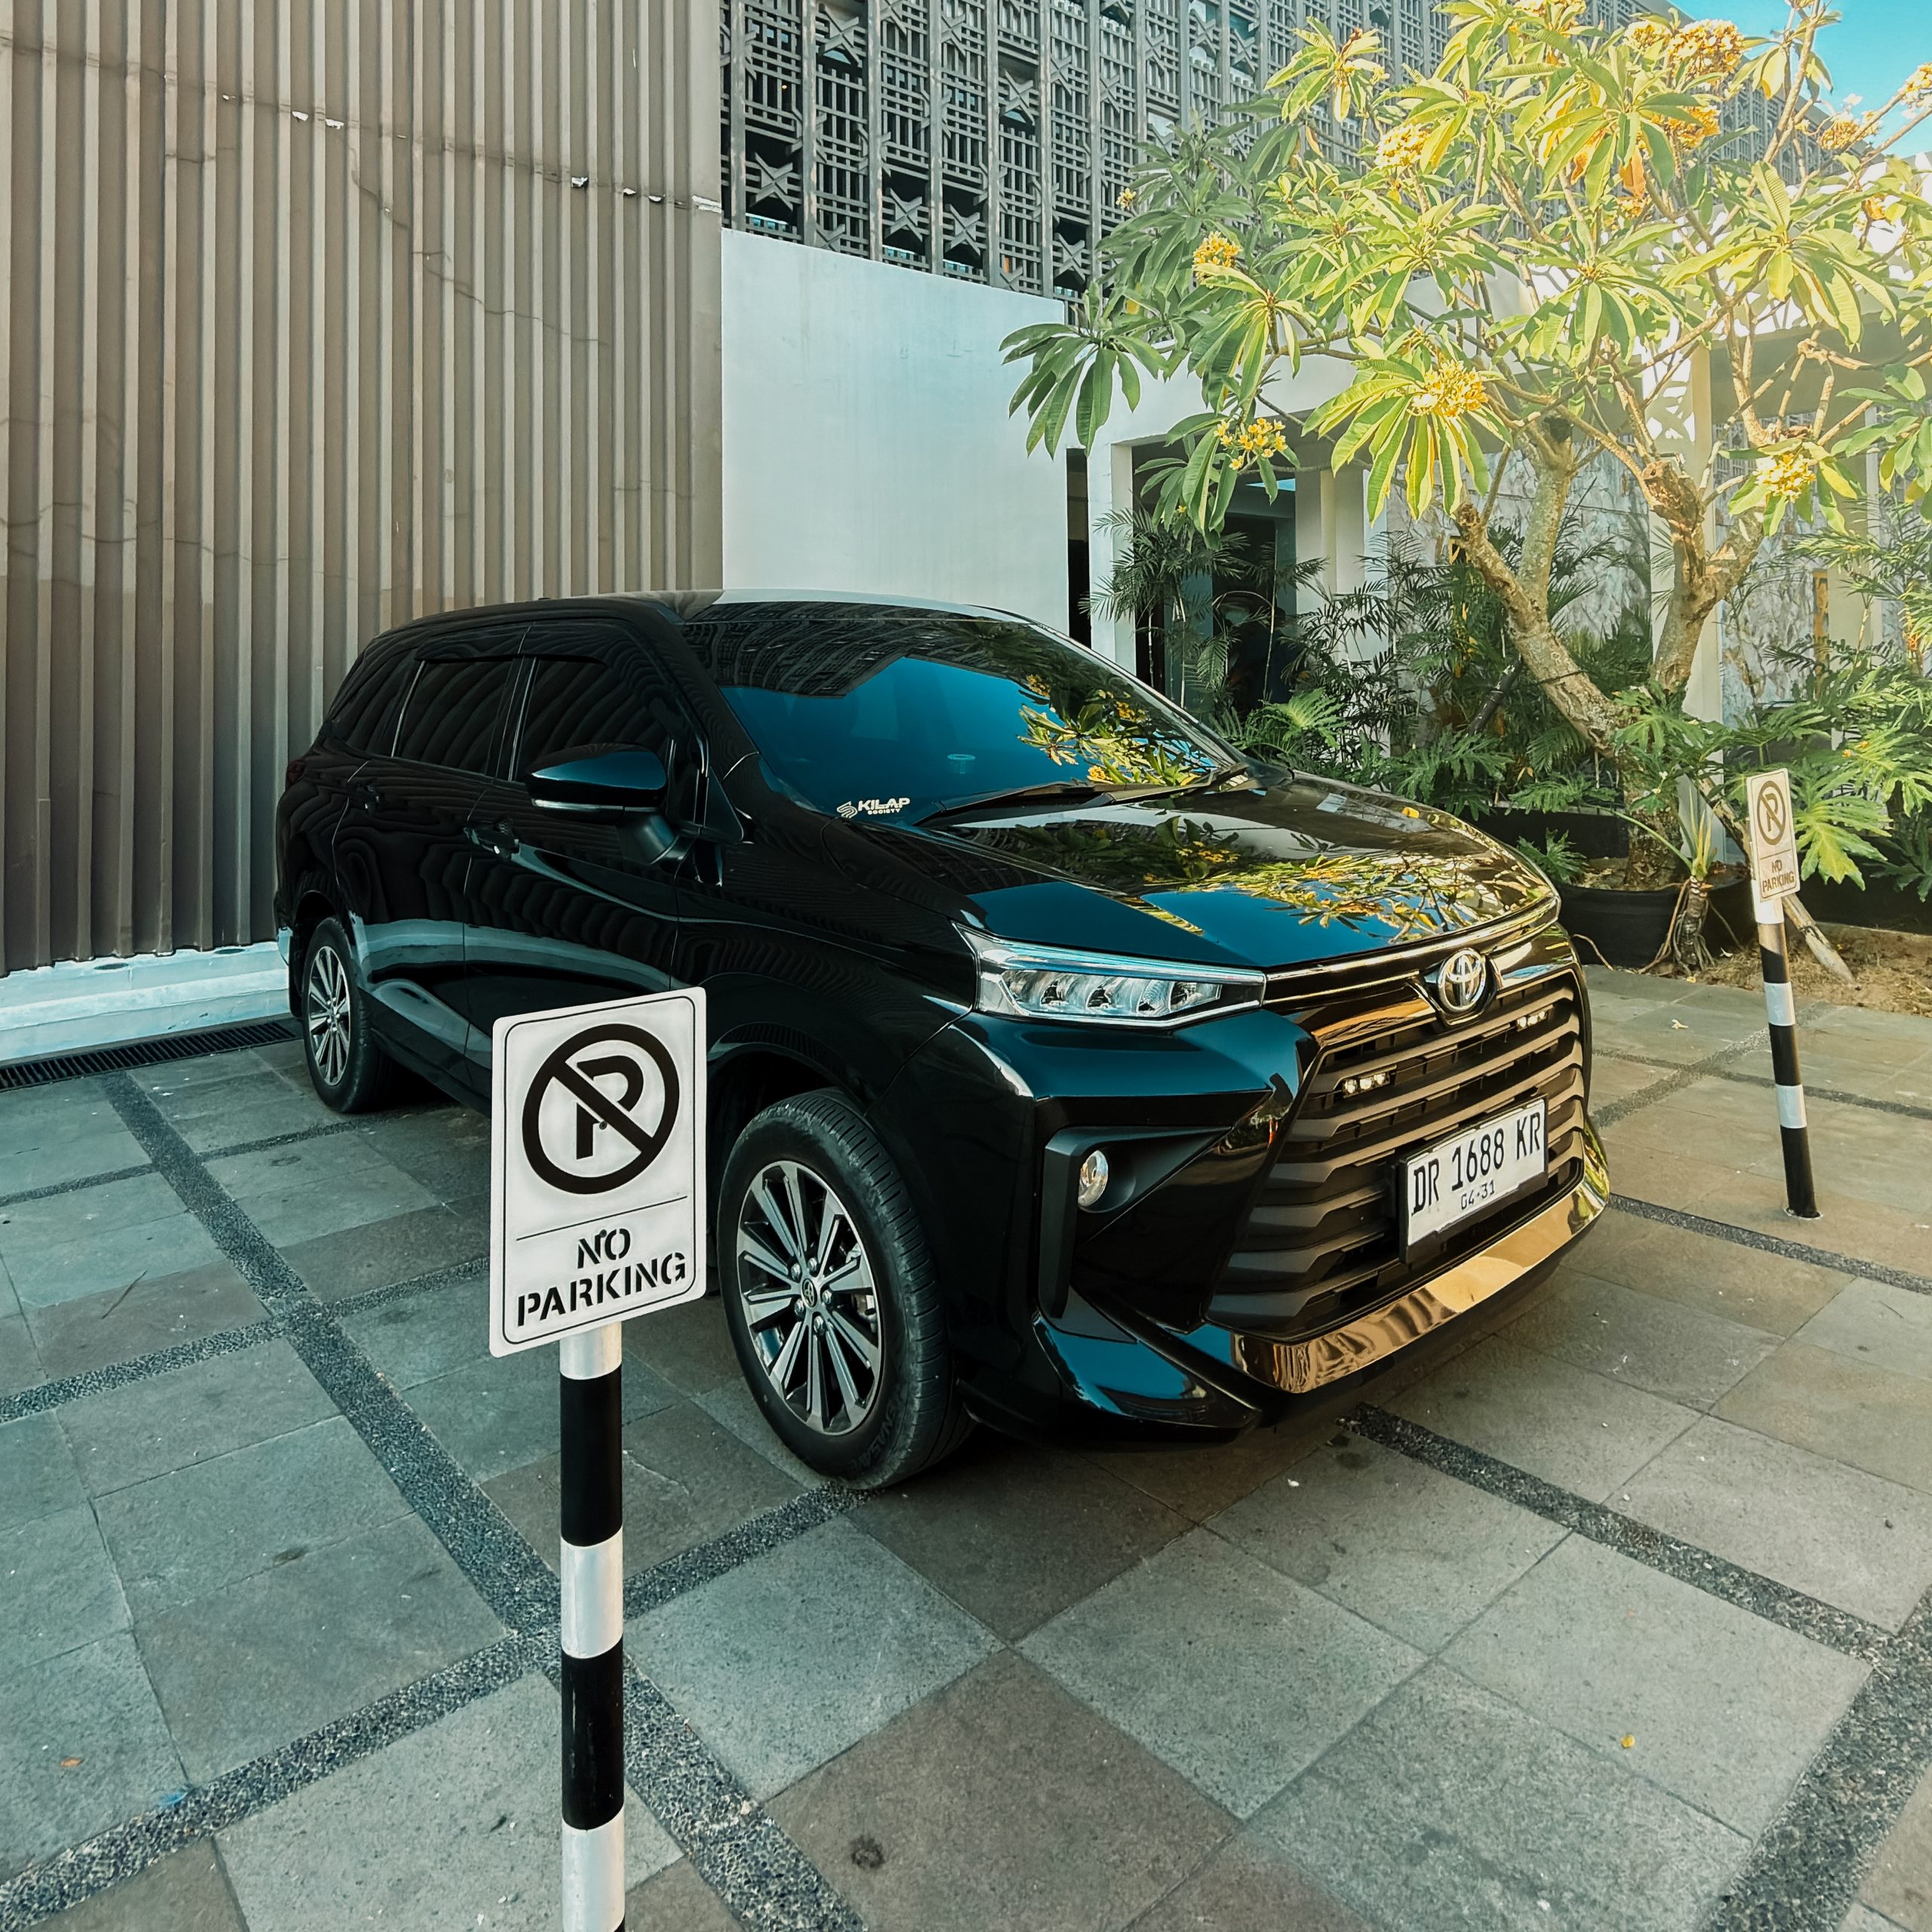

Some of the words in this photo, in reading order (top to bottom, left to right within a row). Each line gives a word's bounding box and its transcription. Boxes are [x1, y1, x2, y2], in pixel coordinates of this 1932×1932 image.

[857, 797, 911, 812] KILAP
[1762, 870, 1795, 893] PARKING
[1771, 859, 1783, 873] NO
[1411, 1157, 1440, 1217] DR
[1451, 1127, 1505, 1192] 1688
[1516, 1111, 1541, 1161] KR
[577, 1226, 632, 1269] NO
[517, 1251, 687, 1327] PARKING
